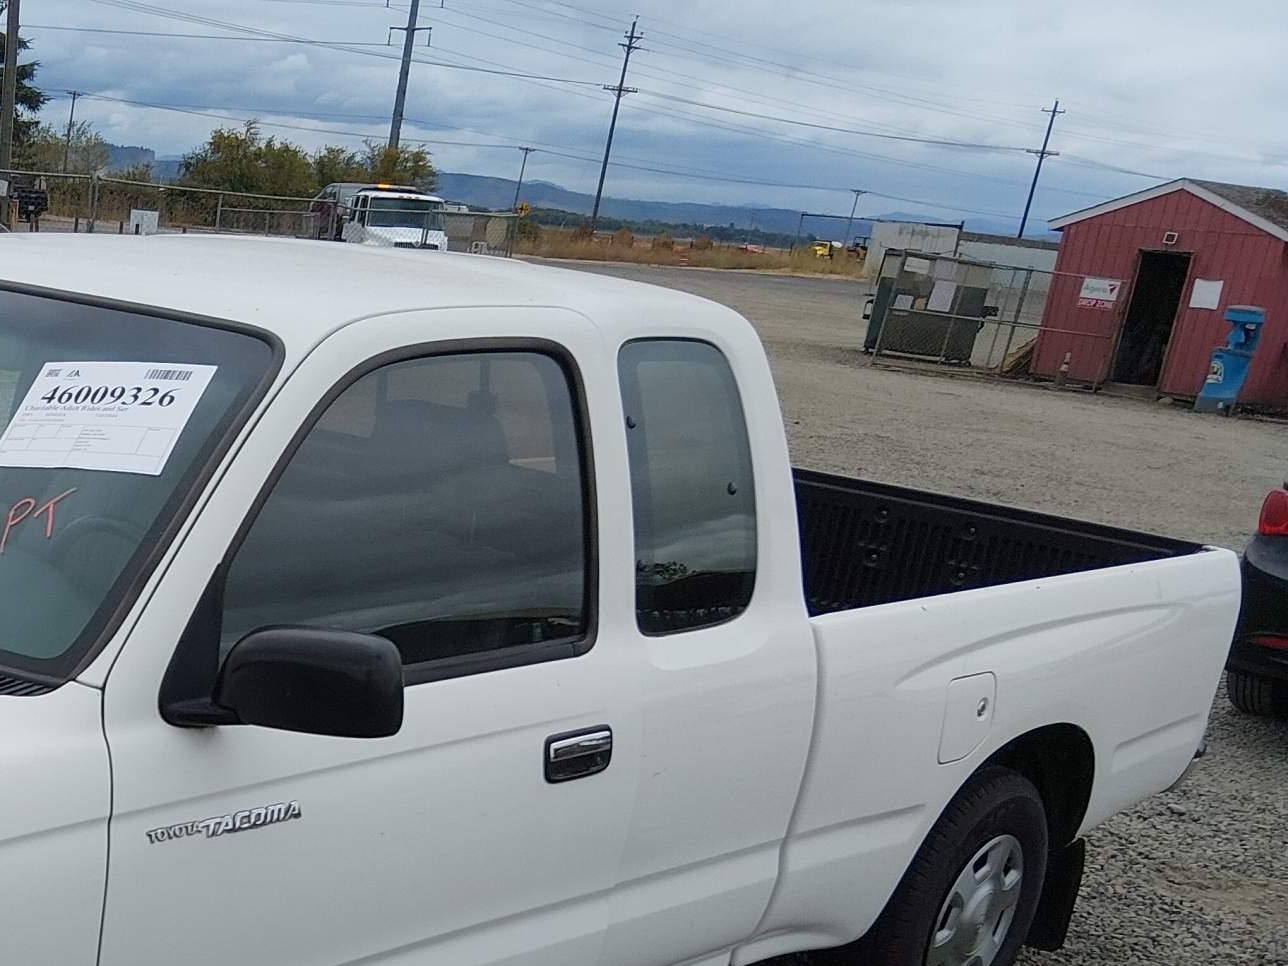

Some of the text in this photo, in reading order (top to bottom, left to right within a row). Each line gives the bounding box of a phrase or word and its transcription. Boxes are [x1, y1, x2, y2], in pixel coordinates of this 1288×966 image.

[40, 385, 181, 407] 46009326
[0, 486, 79, 555] PT
[198, 799, 302, 839] TACOMA
